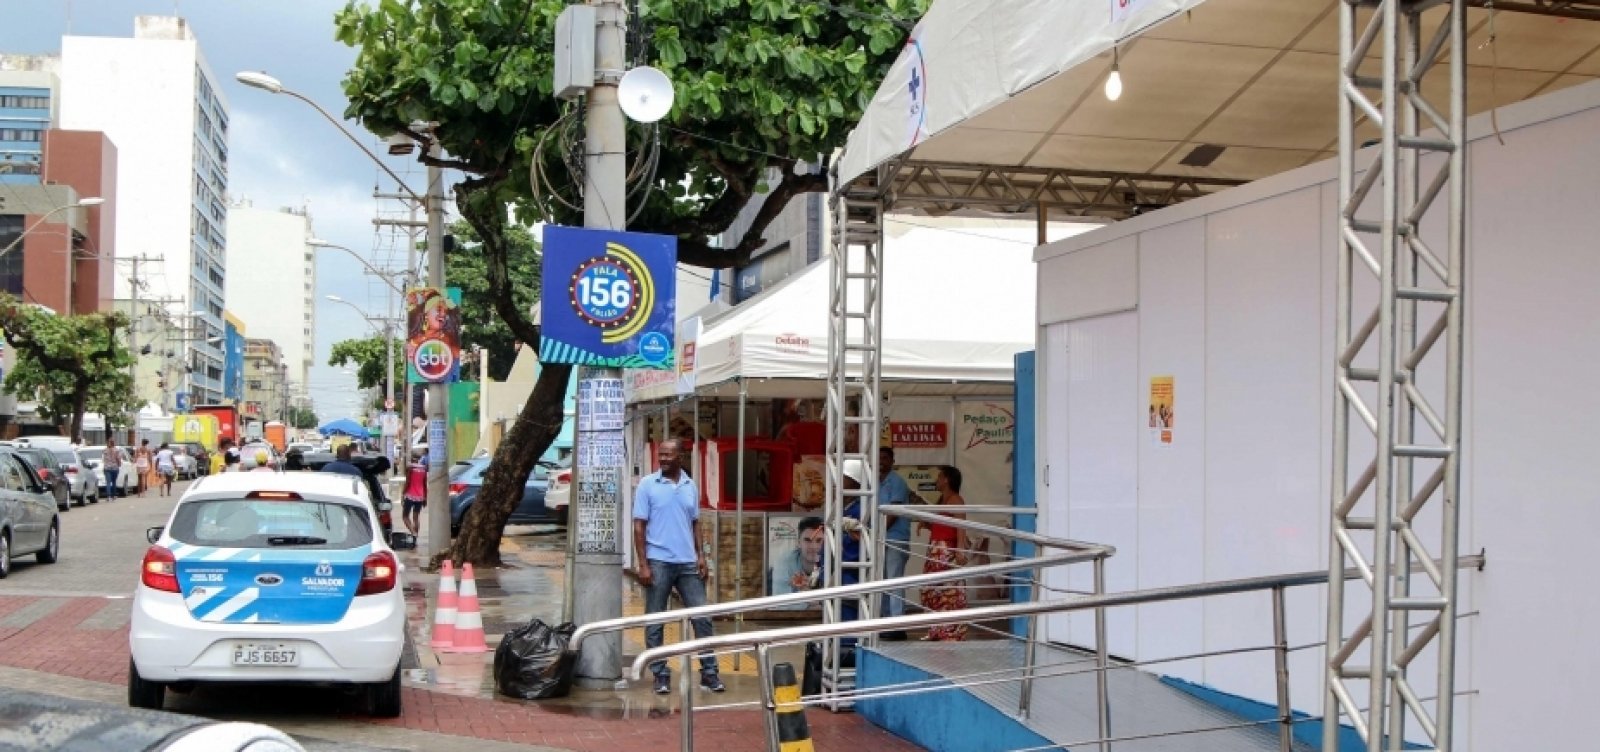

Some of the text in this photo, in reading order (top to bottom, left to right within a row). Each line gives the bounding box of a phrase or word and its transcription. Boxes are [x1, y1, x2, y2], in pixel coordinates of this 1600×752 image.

[579, 276, 631, 309] 156
[420, 346, 448, 366] sbt
[963, 414, 1007, 426] Pedaço
[208, 573, 224, 582] 156
[301, 576, 345, 587] SALVADOR
